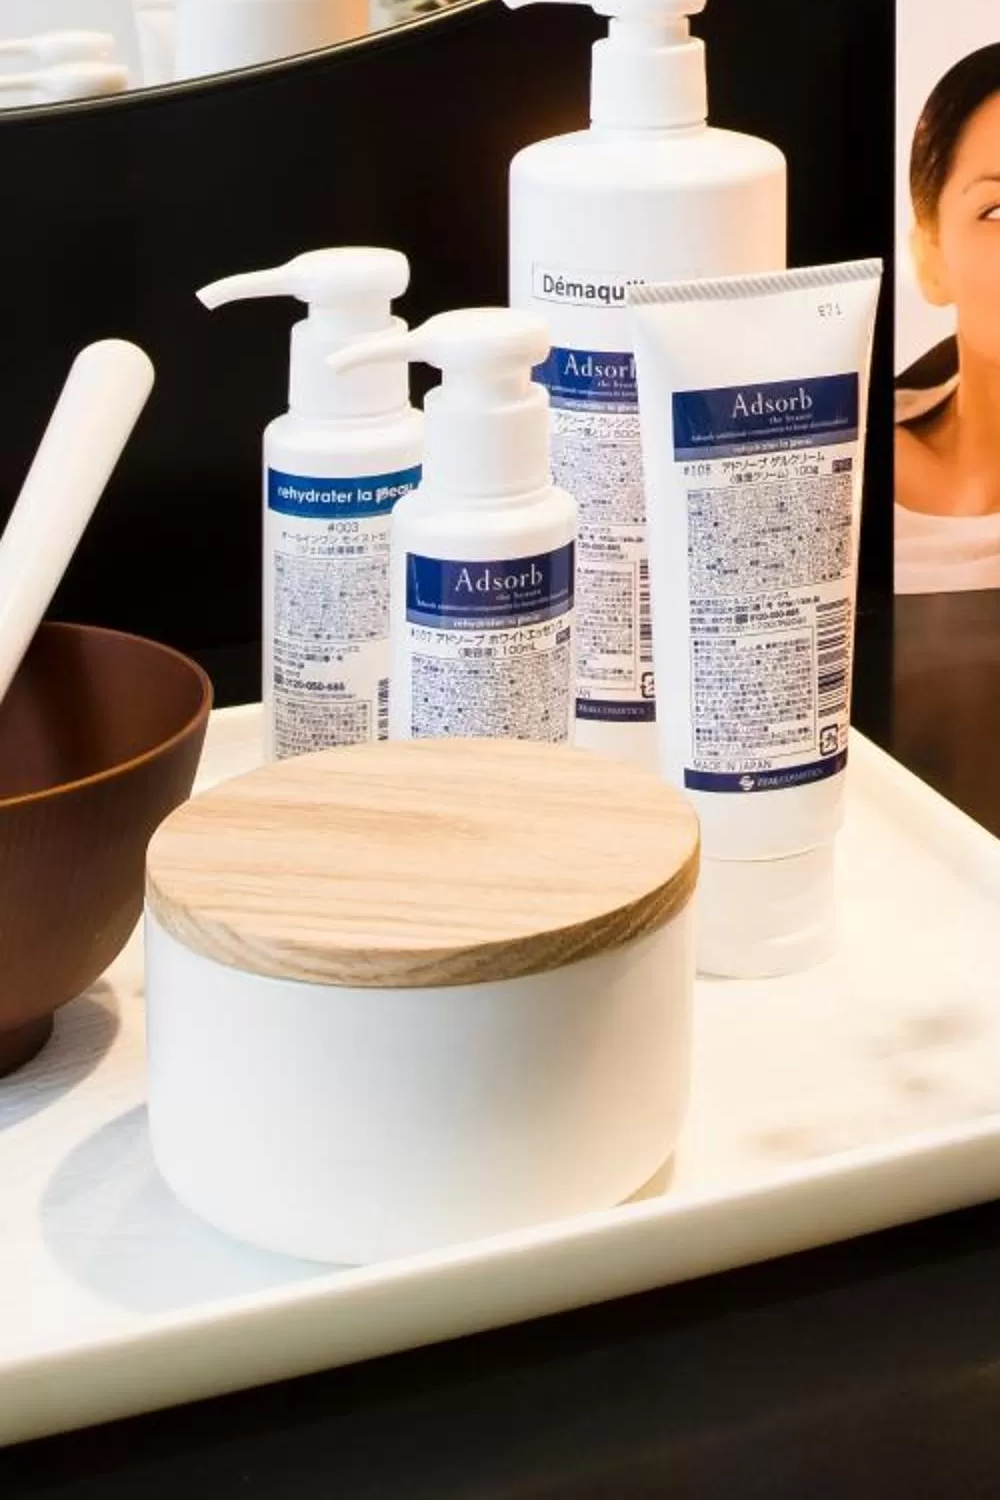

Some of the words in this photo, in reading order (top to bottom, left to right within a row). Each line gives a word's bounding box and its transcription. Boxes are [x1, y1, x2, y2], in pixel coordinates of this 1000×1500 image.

[542, 273, 645, 304] Démaqu
[732, 387, 814, 418] Adsorb
[277, 486, 352, 504] rehydrater
[357, 488, 372, 501] la
[454, 563, 544, 592] Adsorb
